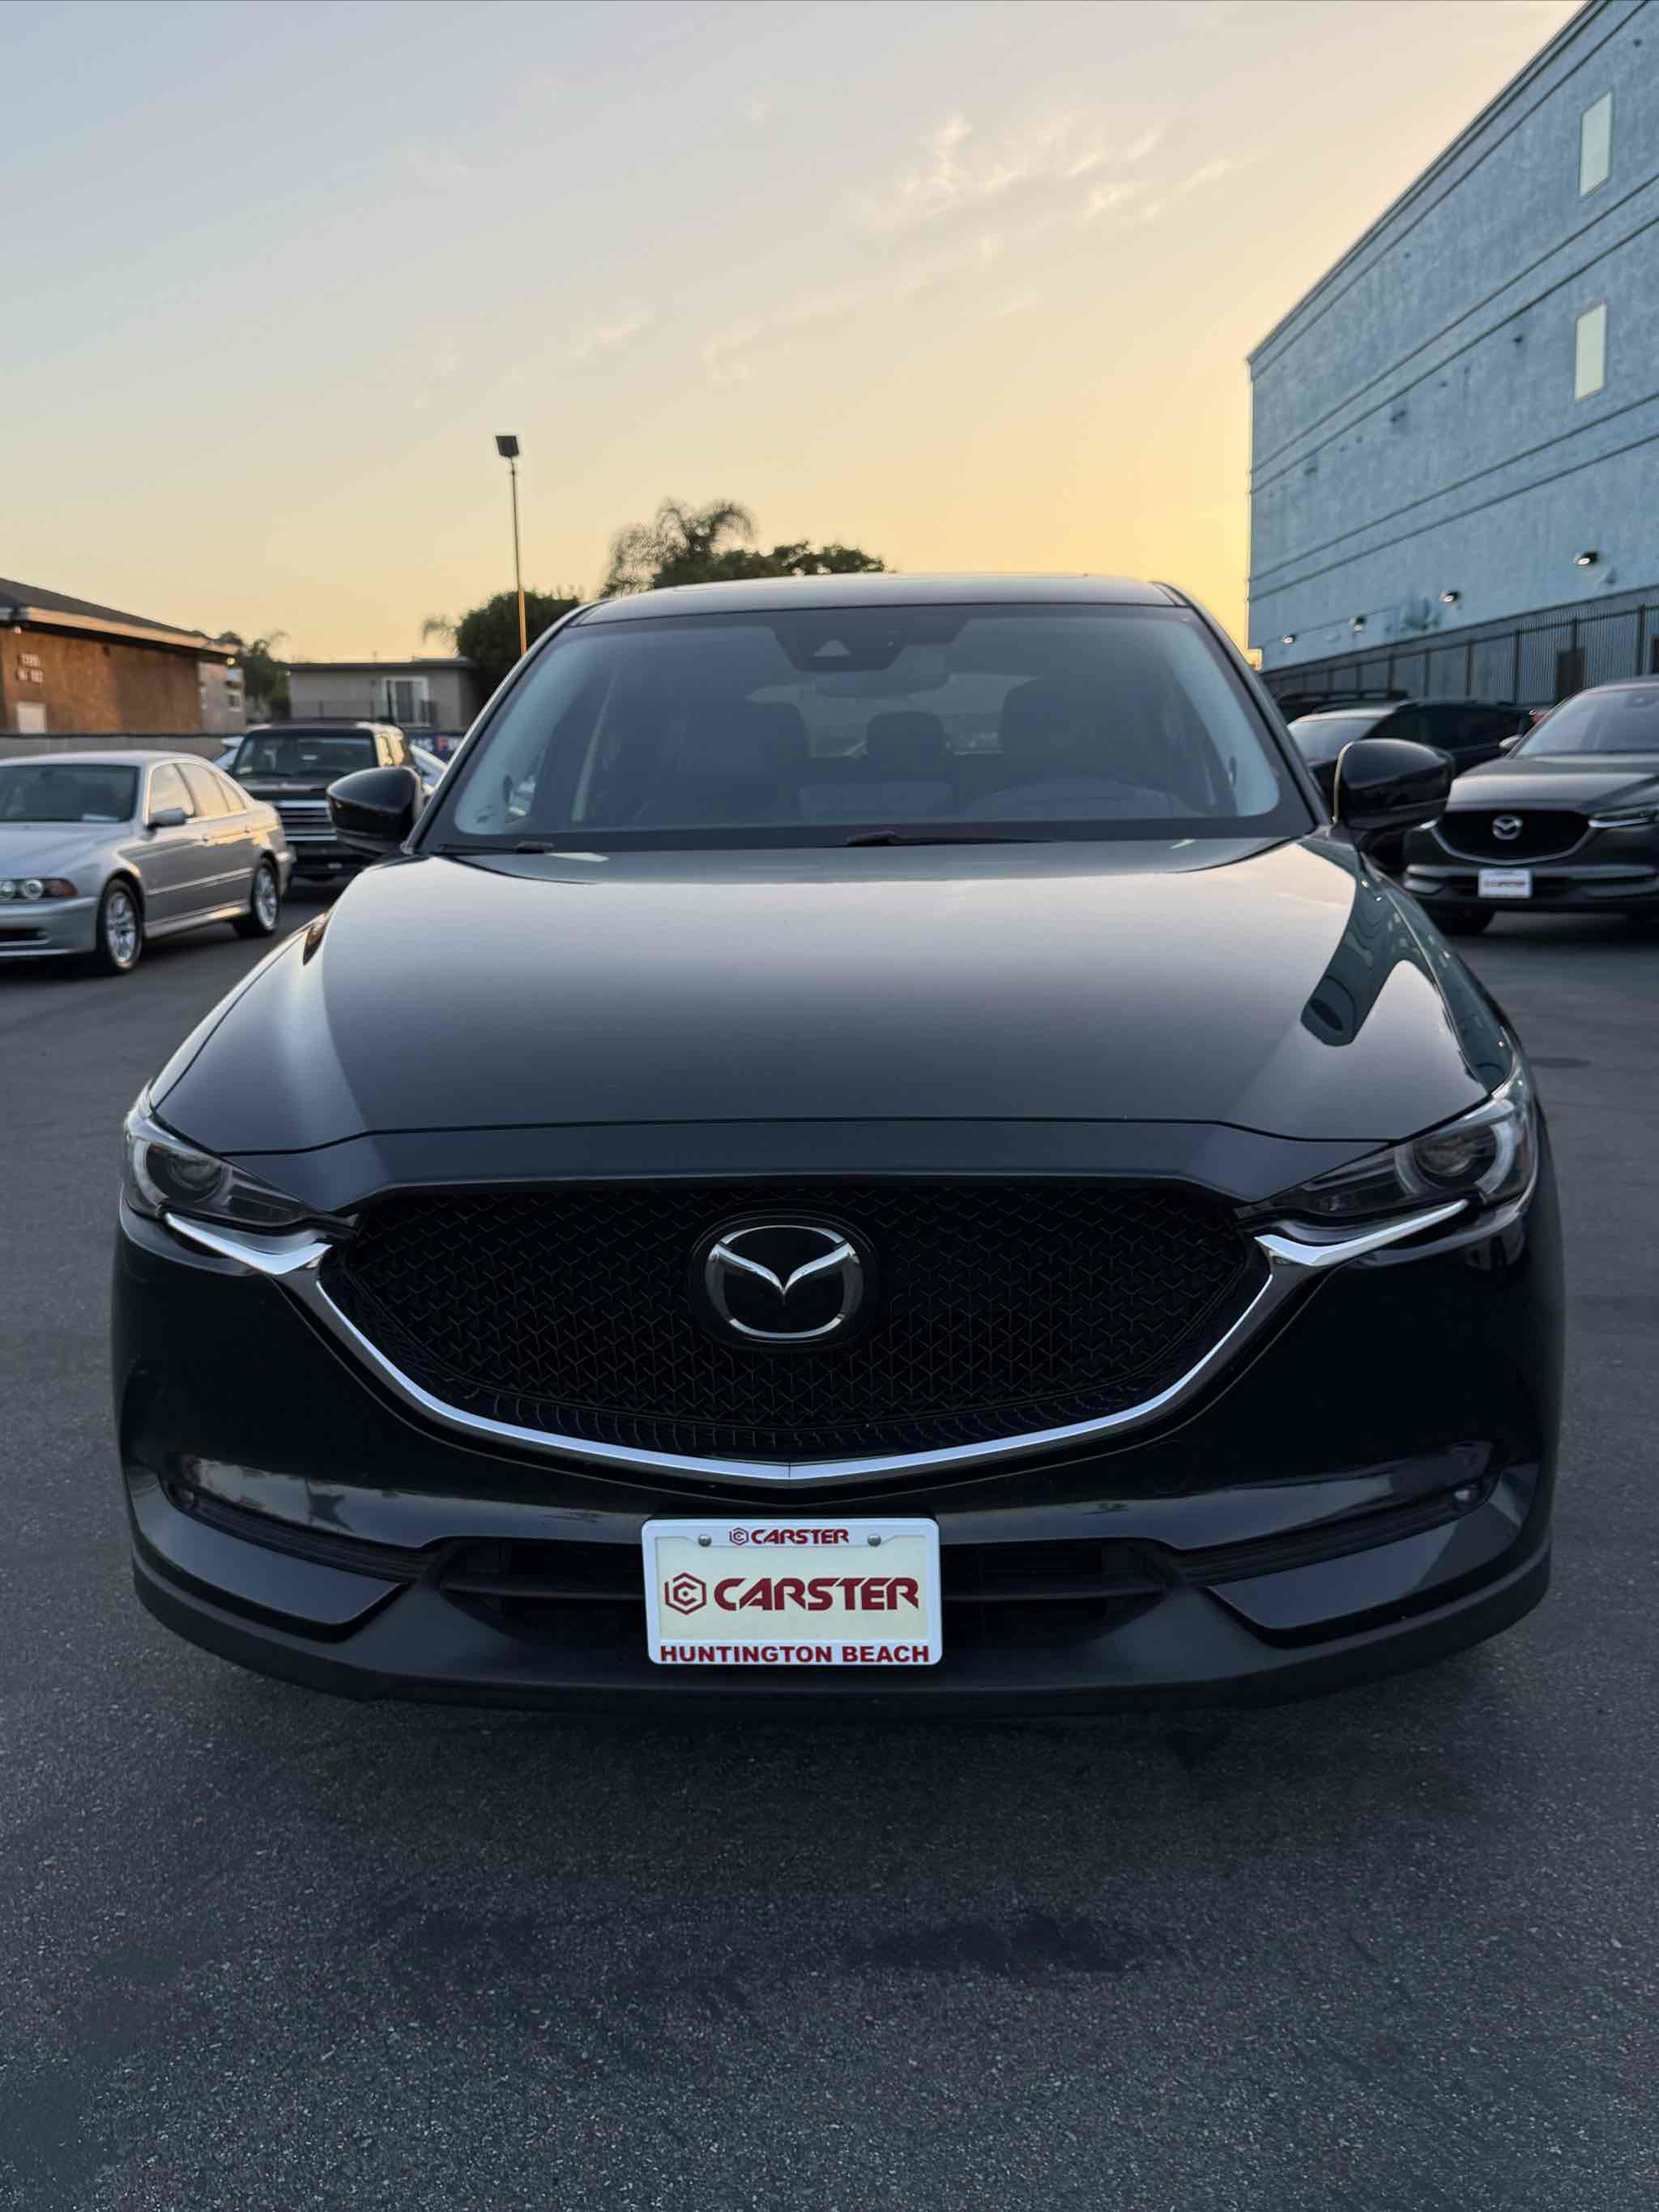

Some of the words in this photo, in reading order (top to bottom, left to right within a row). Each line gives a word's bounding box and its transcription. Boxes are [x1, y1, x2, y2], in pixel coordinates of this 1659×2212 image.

[751, 1528, 849, 1545] CARSTER
[714, 1577, 919, 1611] CARSTER
[660, 1645, 832, 1663] HUNTINGTON
[842, 1645, 930, 1663] BEACH
